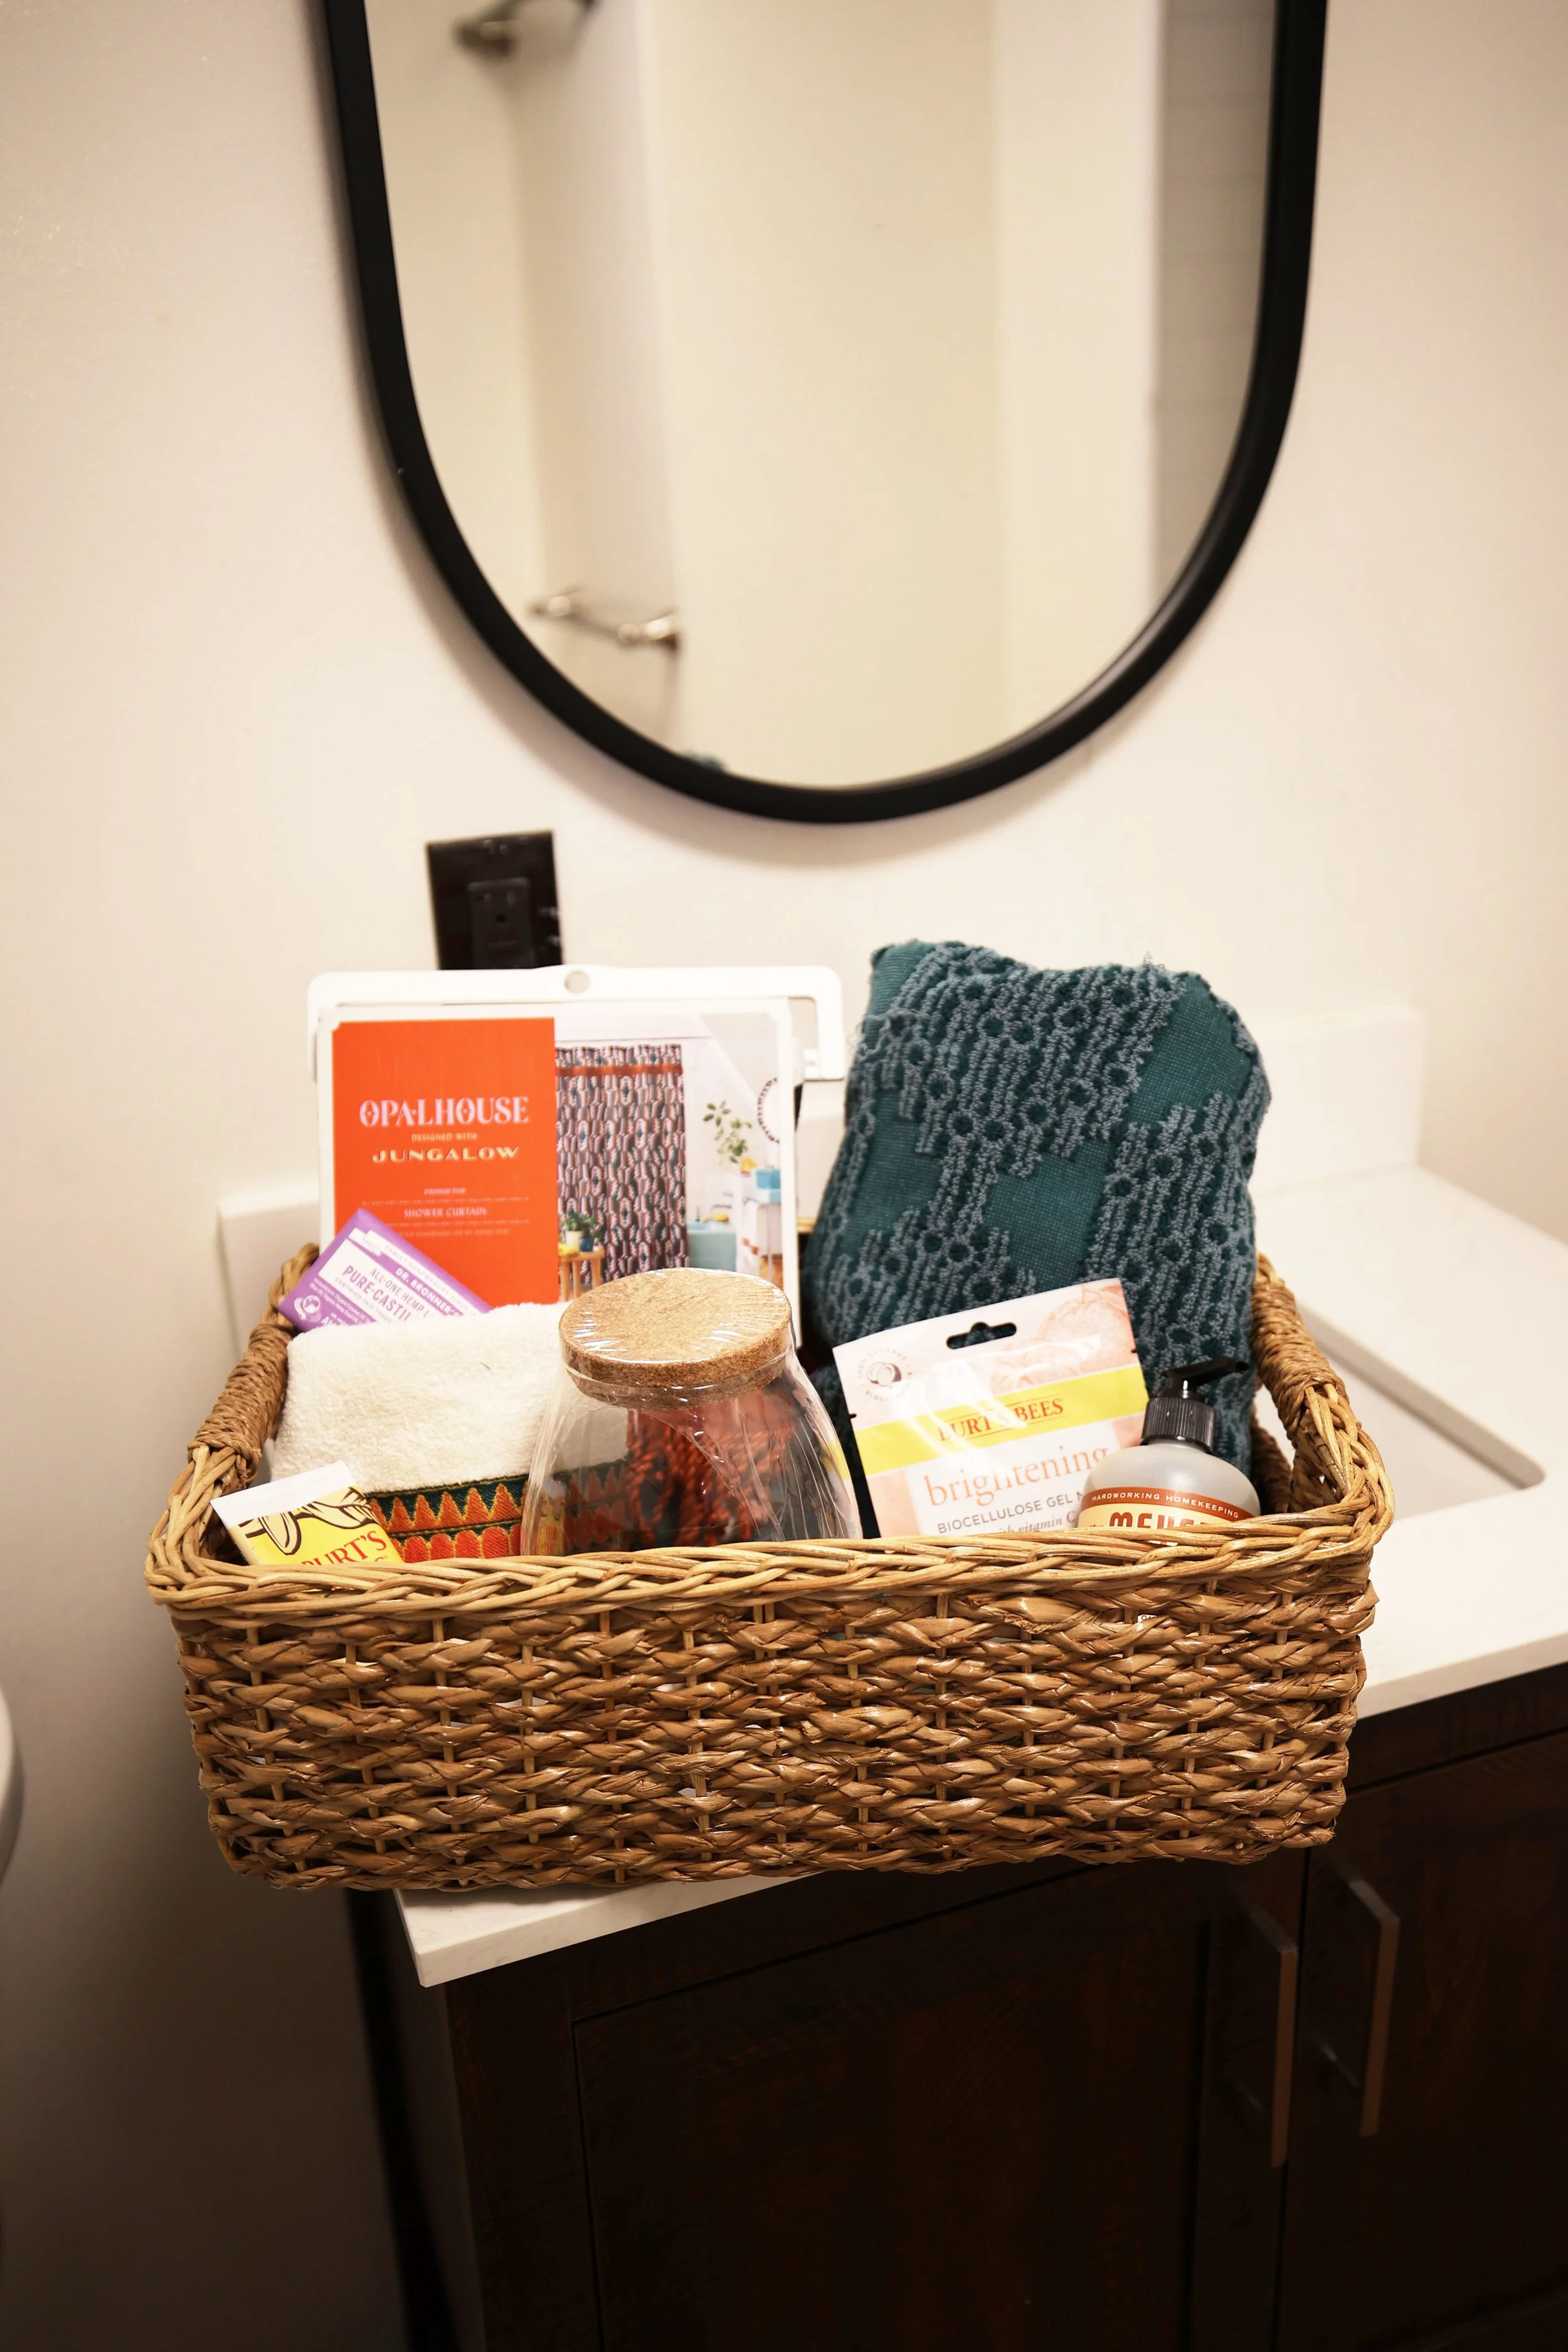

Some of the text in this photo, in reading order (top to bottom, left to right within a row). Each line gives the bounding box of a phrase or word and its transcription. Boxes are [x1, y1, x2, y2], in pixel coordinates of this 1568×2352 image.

[359, 1096, 529, 1128] OPALHOUSE
[411, 1132, 477, 1142] DESIGNED WITH
[371, 1146, 519, 1163] JUNGALOW
[403, 1207, 487, 1218] SHOWER CURTAIN
[395, 1267, 411, 1282] DR.
[369, 1268, 423, 1312] ALL-ONE HEMP
[938, 1500, 1042, 1534] BIOCELLULOSE
[1046, 1493, 1073, 1507] GEL
[1092, 1492, 1160, 1502] HARDWORKING
[1165, 1495, 1239, 1519] HOMEKEEPING
